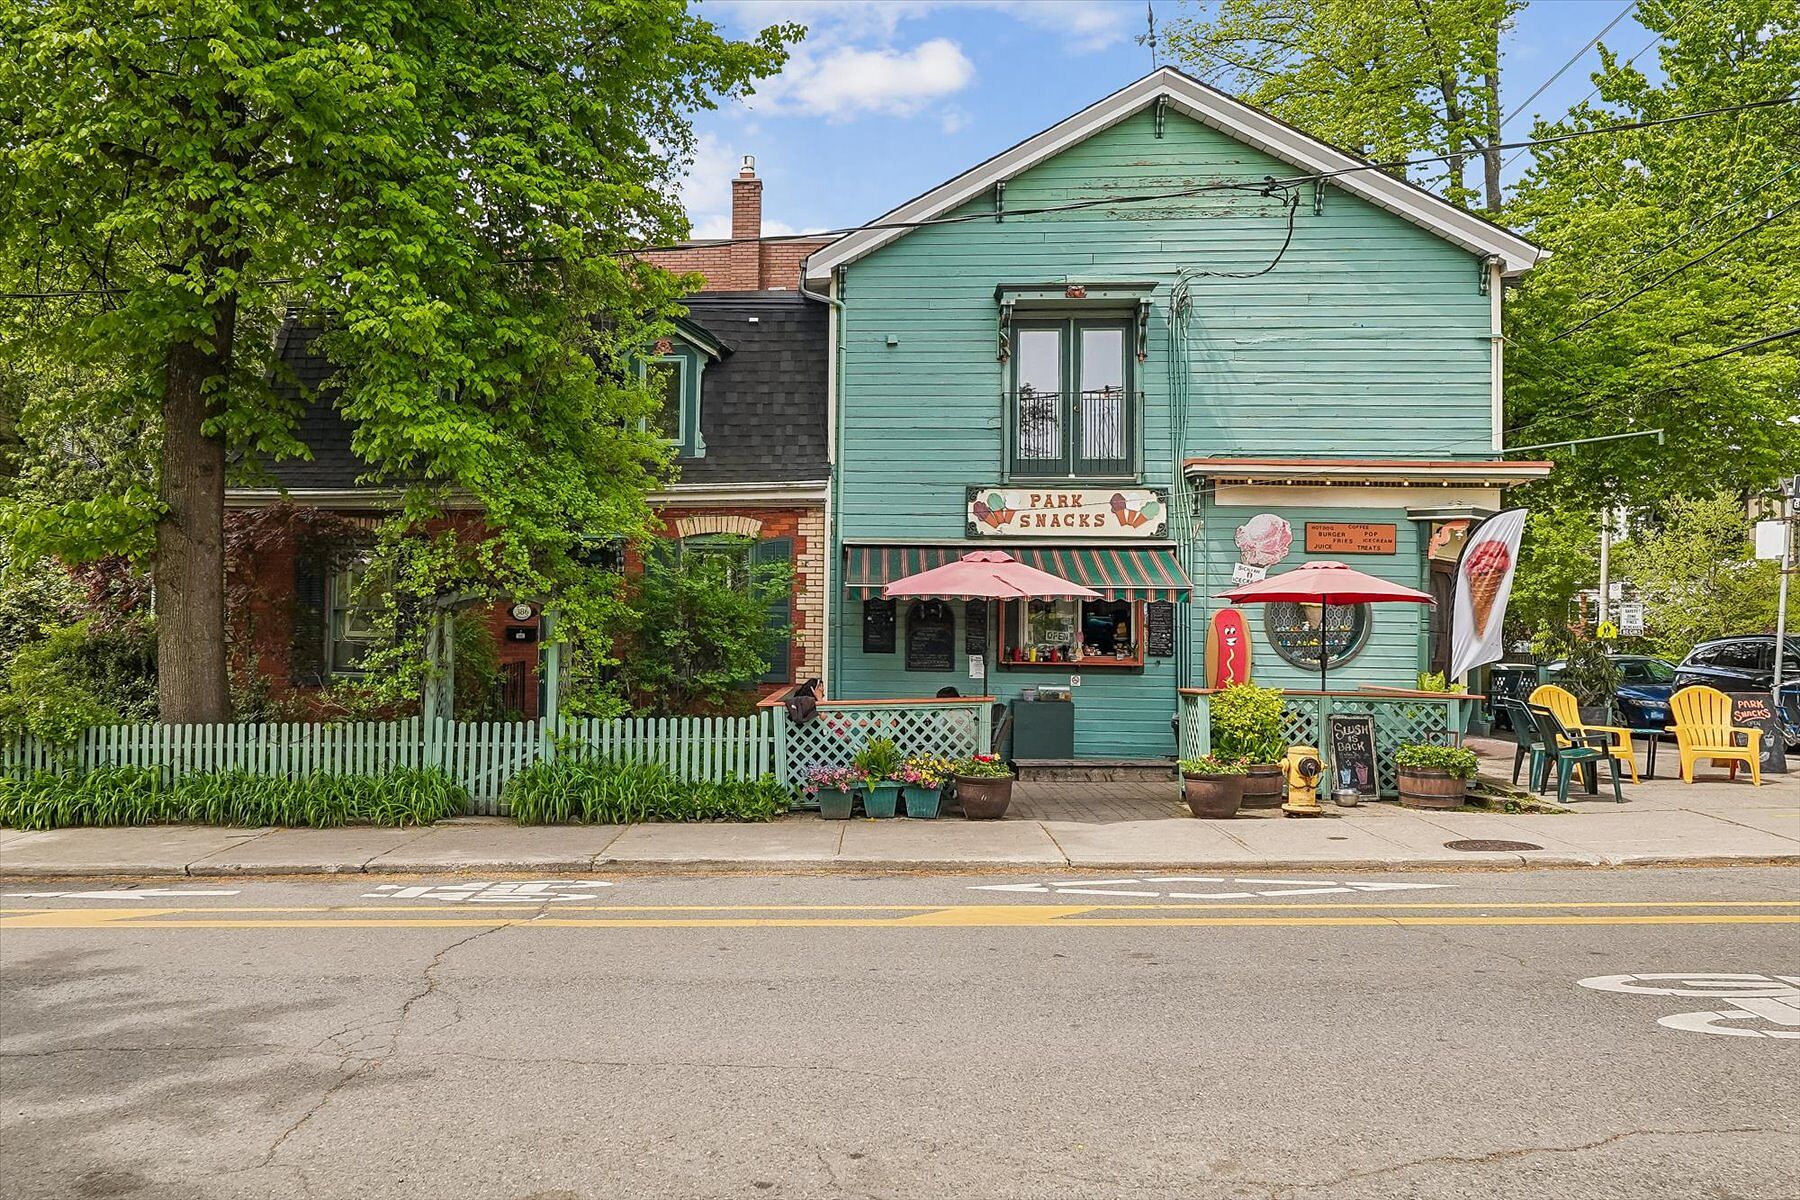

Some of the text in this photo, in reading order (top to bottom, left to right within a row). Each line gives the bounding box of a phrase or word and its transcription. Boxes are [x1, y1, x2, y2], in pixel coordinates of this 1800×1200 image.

[1030, 493, 1083, 507] PARK
[1019, 513, 1105, 528] SNACKS
[1047, 631, 1069, 640] OPEN
[1738, 700, 1764, 709] PARK
[1734, 708, 1770, 721] SNACKS
[1347, 735, 1359, 743] IS
[1337, 742, 1365, 751] BACK
